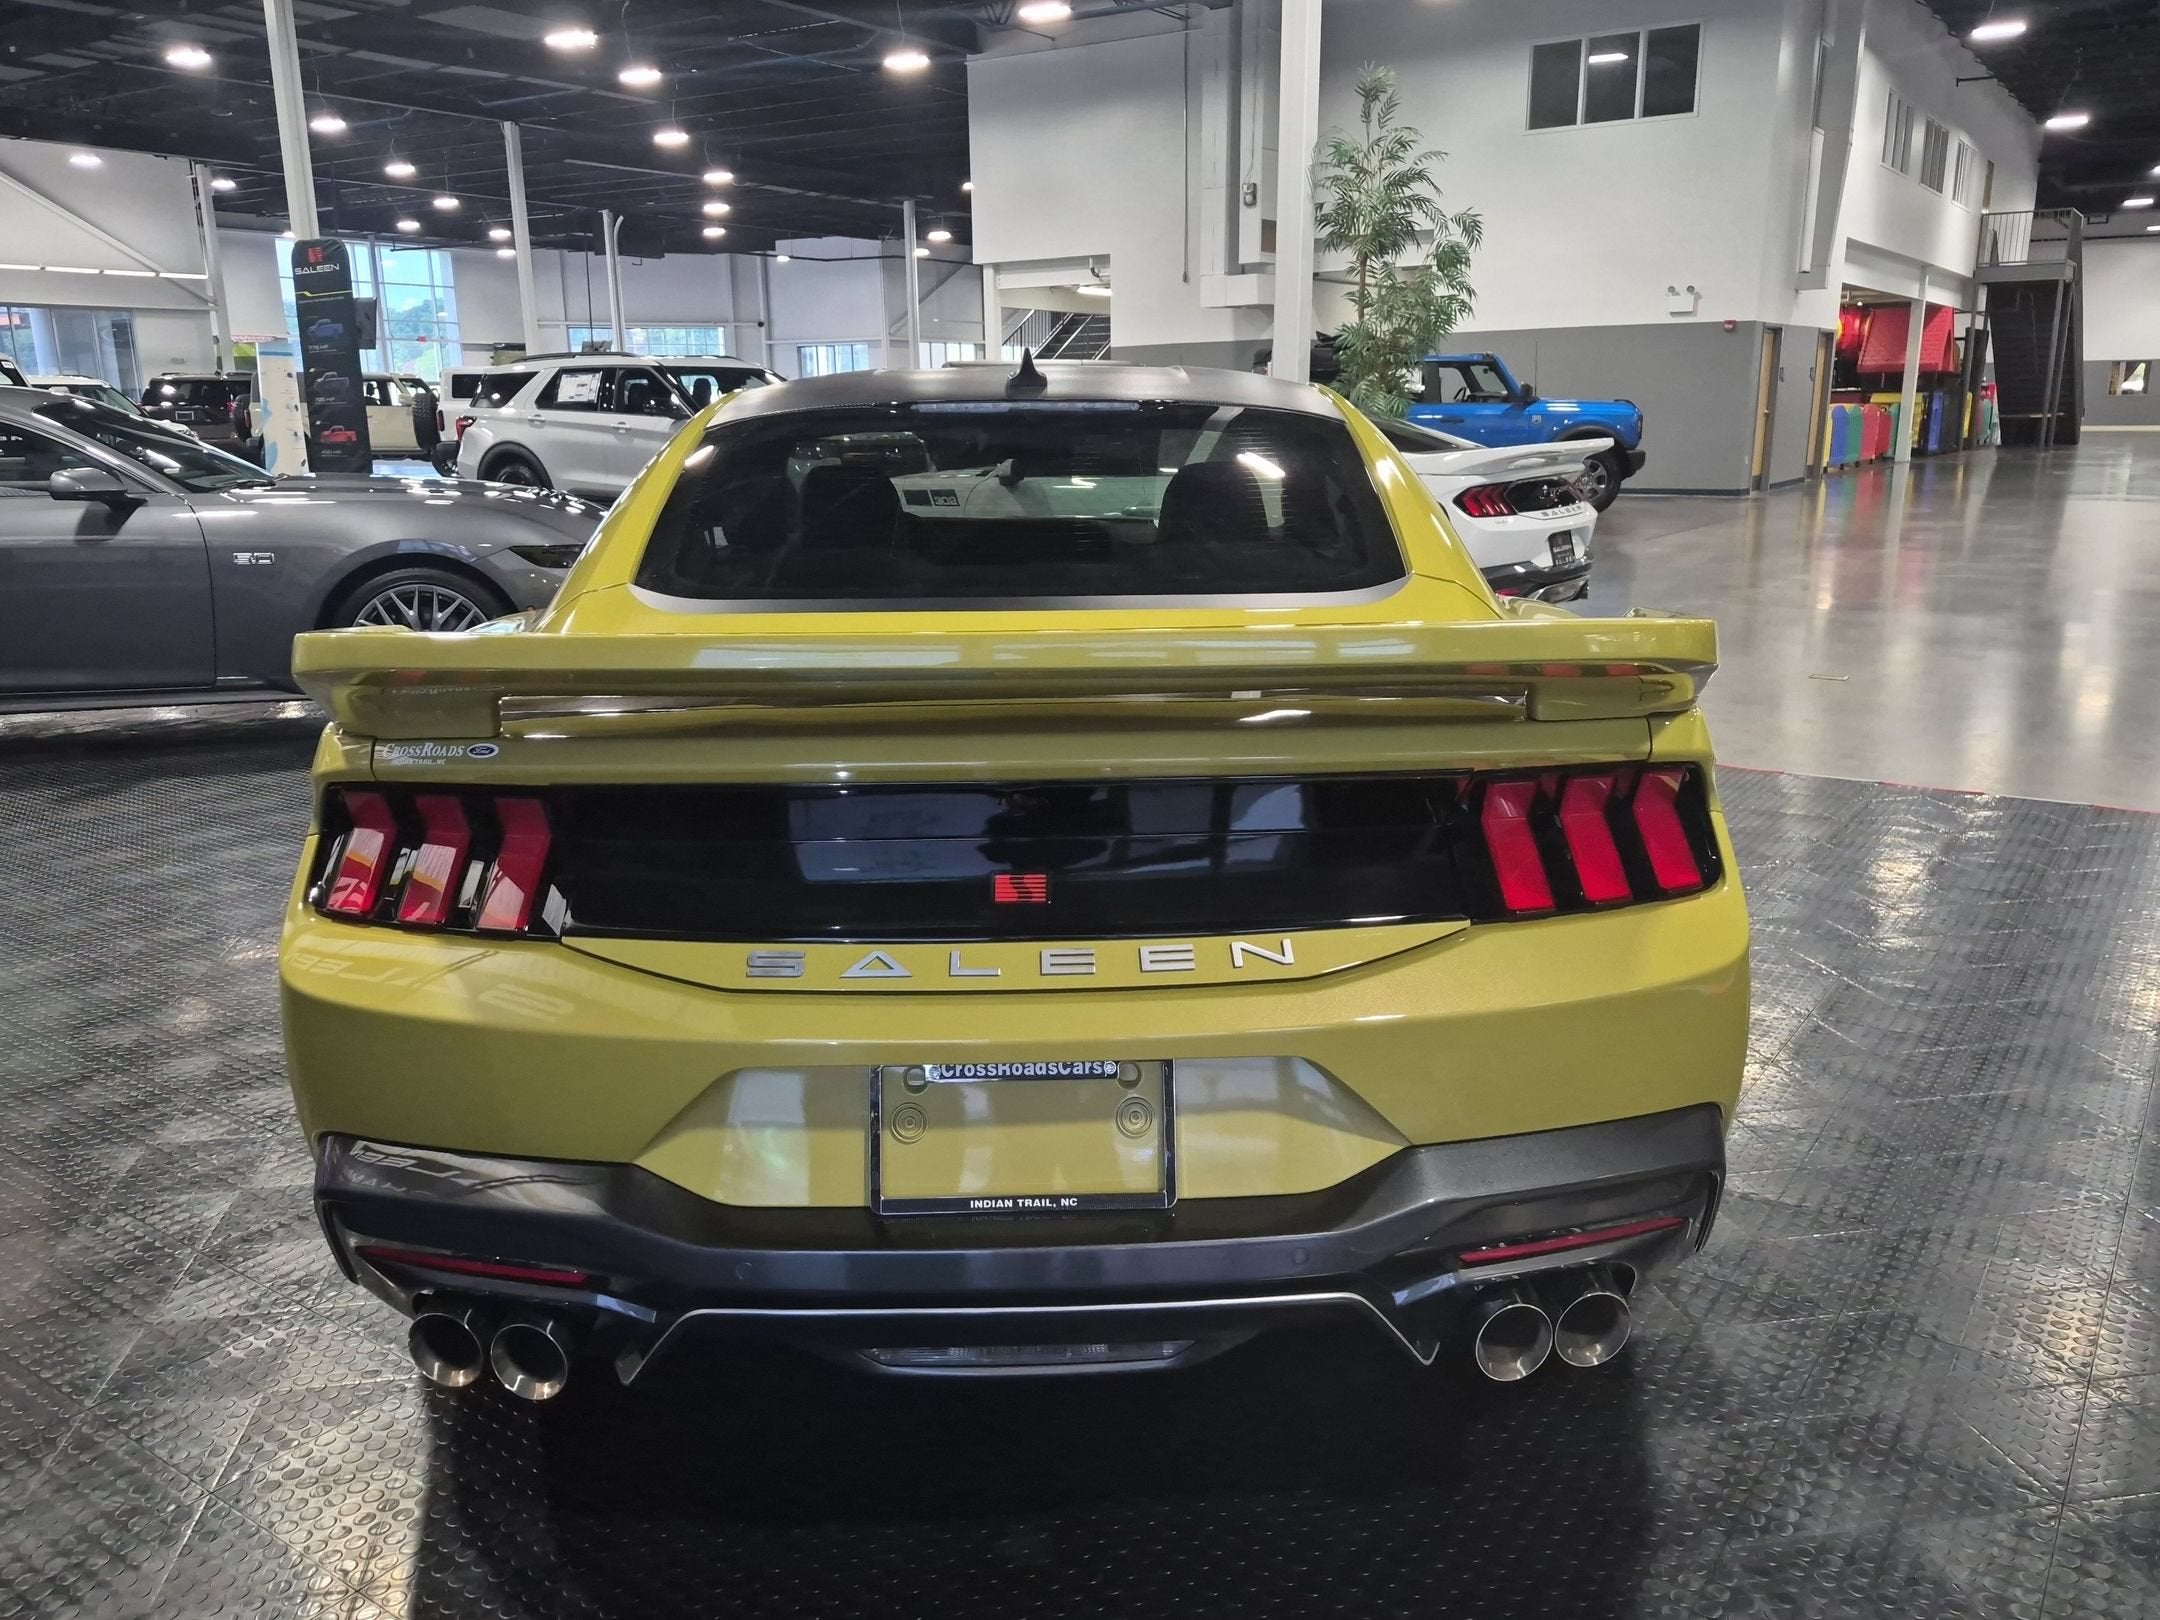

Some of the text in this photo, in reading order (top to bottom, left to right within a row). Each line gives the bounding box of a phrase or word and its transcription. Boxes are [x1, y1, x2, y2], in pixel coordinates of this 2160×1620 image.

[294, 264, 340, 275] SALEEN
[933, 495, 958, 505] 302
[746, 938, 1295, 978] SALEEN
[970, 1198, 1078, 1208] INDIAN TRAIL, NC
